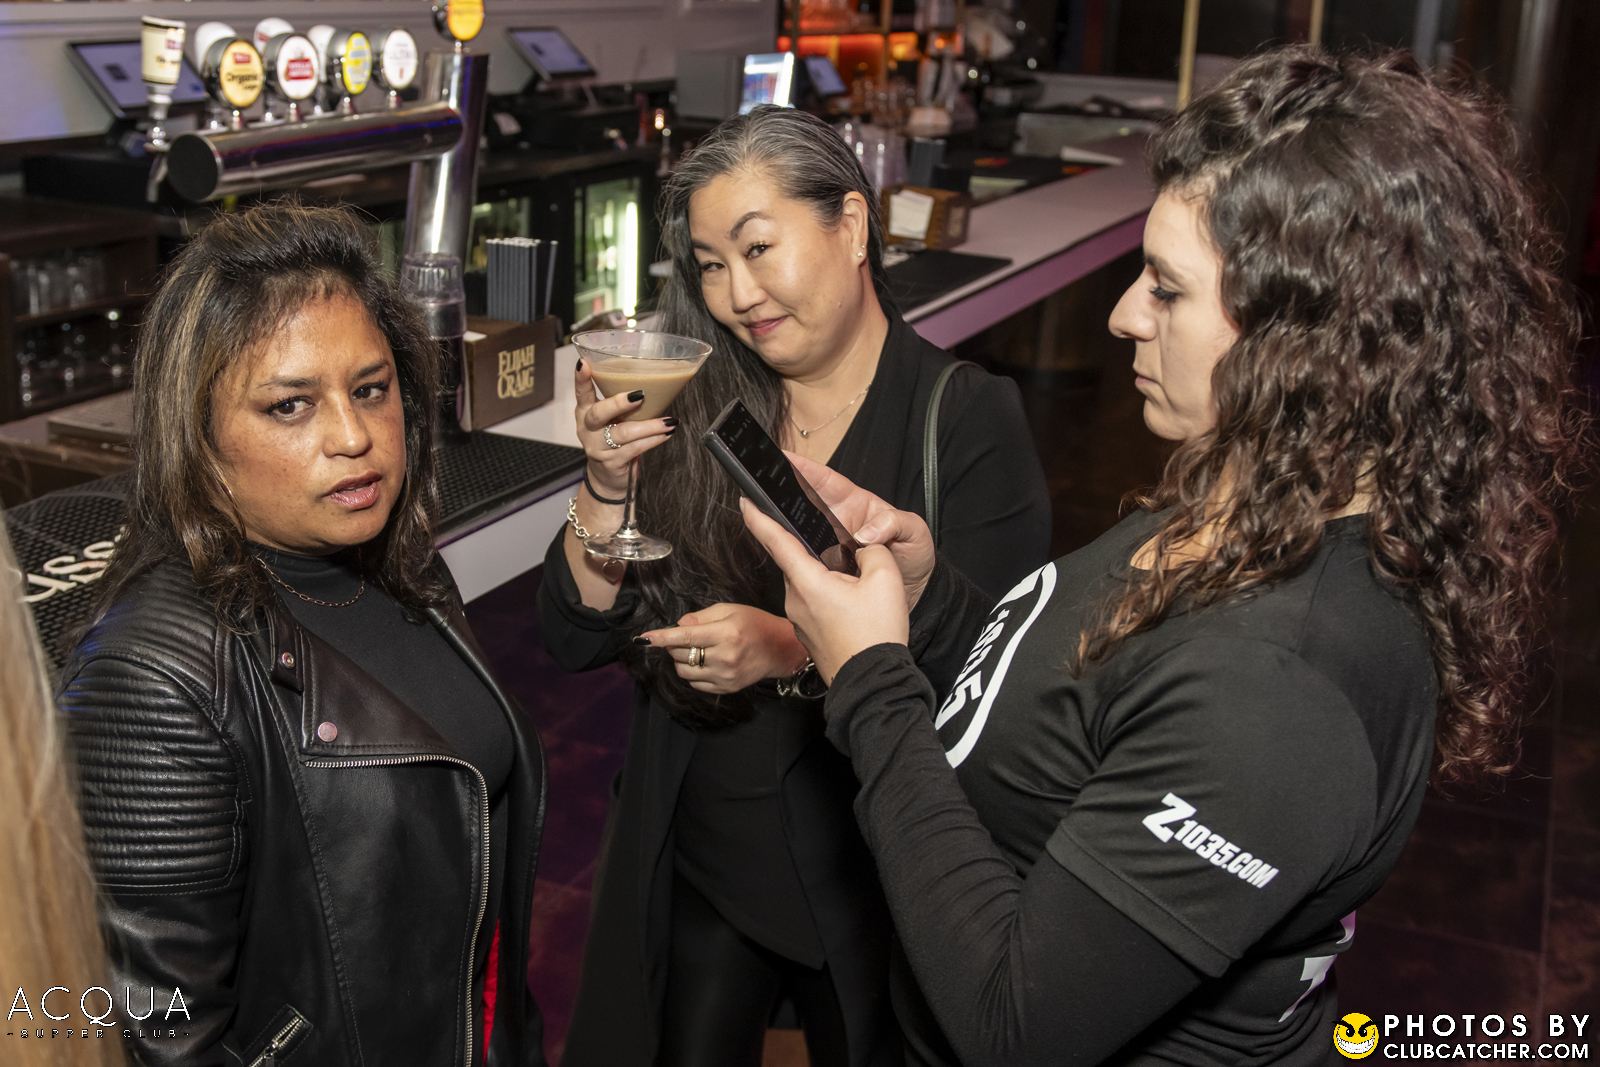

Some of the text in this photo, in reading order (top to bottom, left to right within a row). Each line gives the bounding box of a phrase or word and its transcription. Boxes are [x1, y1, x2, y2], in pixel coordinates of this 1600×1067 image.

[498, 344, 535, 375] ELIJAH
[497, 366, 535, 399] CRAIG
[1142, 792, 1279, 889] Z1035.COM
